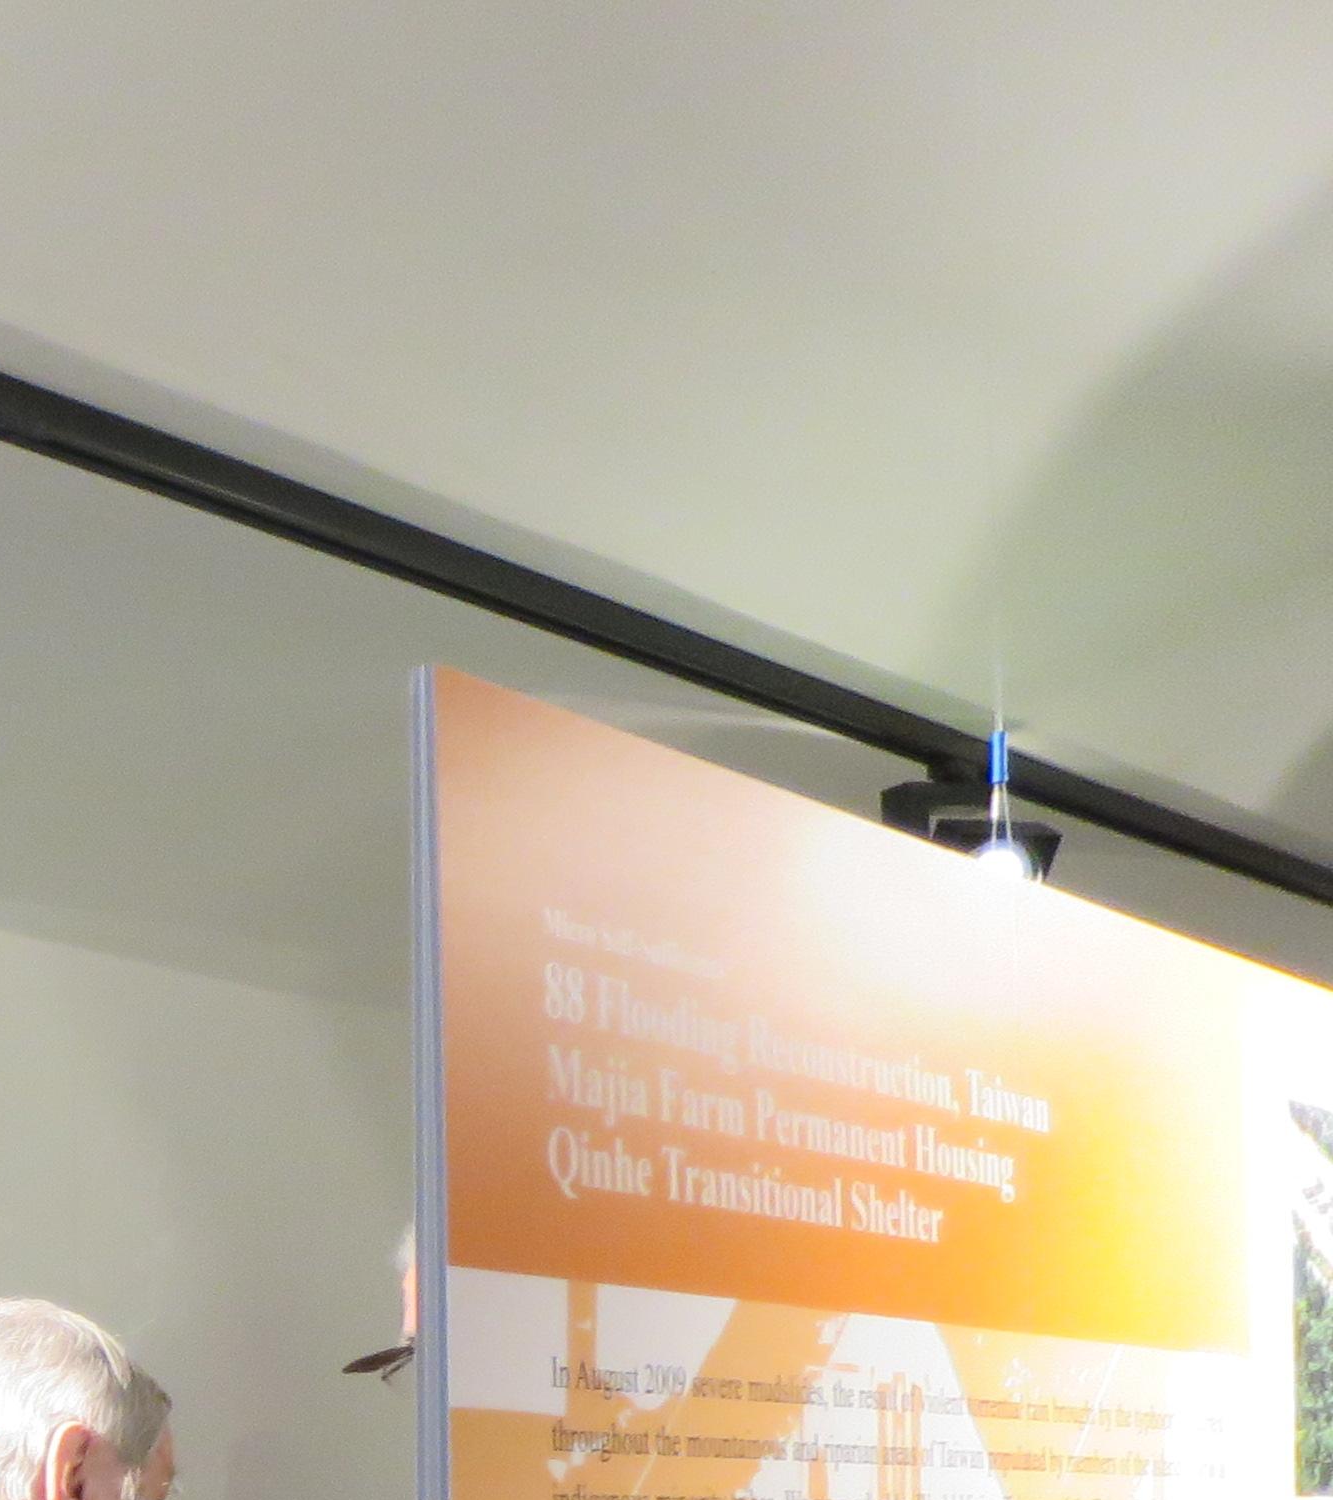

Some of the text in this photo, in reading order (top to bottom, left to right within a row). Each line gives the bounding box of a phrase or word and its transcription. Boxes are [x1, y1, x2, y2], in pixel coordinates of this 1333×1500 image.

[544, 960, 1053, 1134] 88 Flooding Reconstruction, Taiwan
[546, 1044, 1017, 1203] Majia Farm Permanent Housing
[547, 1126, 943, 1243] Qinhe Transitional Shelter
[552, 1357, 569, 1389] In
[576, 1359, 638, 1399] August
[644, 1364, 687, 1396] 2009
[692, 1376, 742, 1400] severe
[833, 1380, 854, 1408] the
[552, 1421, 648, 1461] throughout
[656, 1426, 679, 1456] the
[792, 1434, 818, 1462] and
